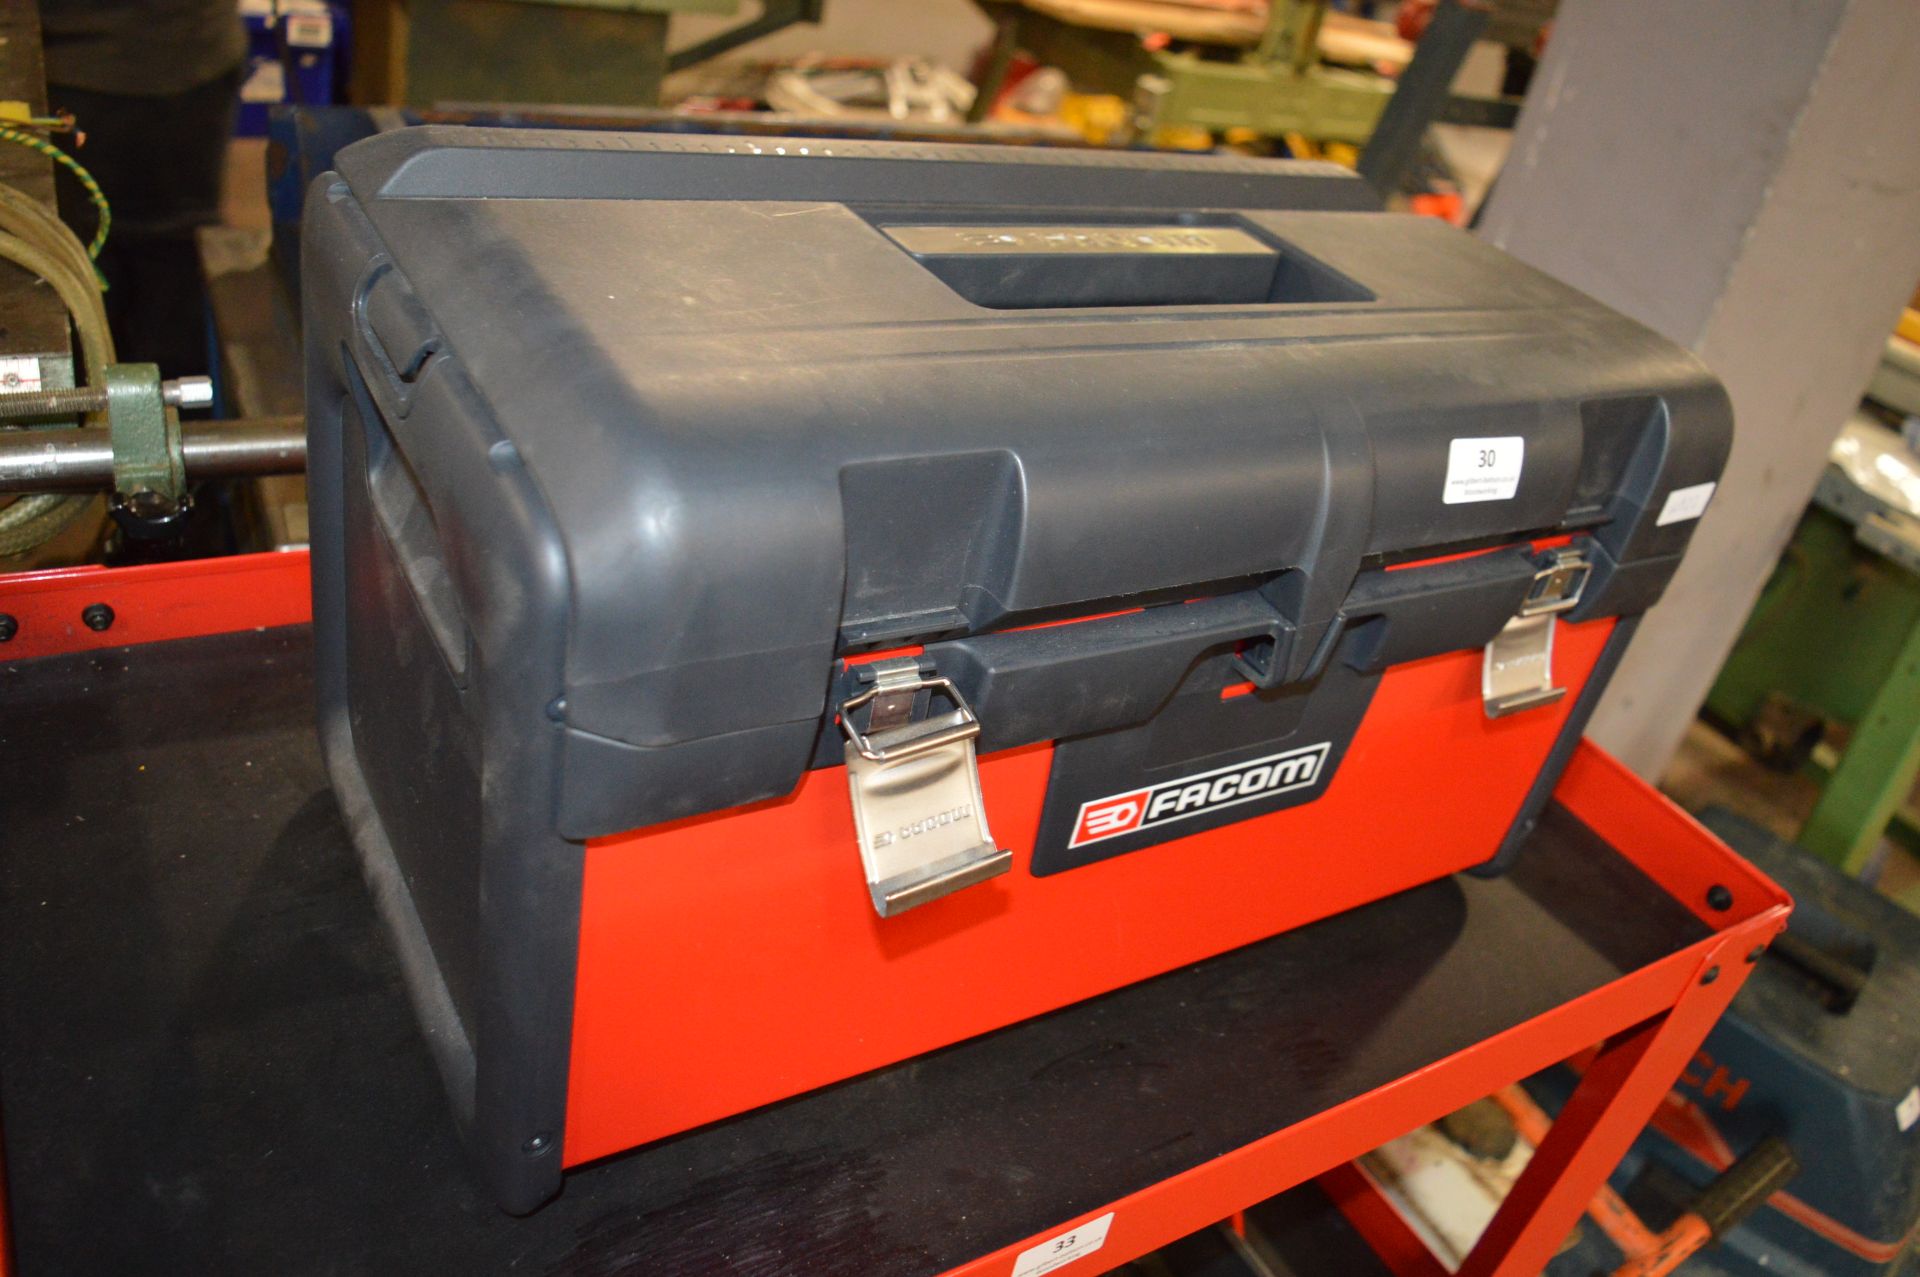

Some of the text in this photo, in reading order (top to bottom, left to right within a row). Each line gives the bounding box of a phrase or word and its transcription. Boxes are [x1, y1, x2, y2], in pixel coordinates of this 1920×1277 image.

[1478, 449, 1496, 468] 30
[1147, 754, 1319, 820] FACOM
[1052, 1235, 1077, 1254] 33
